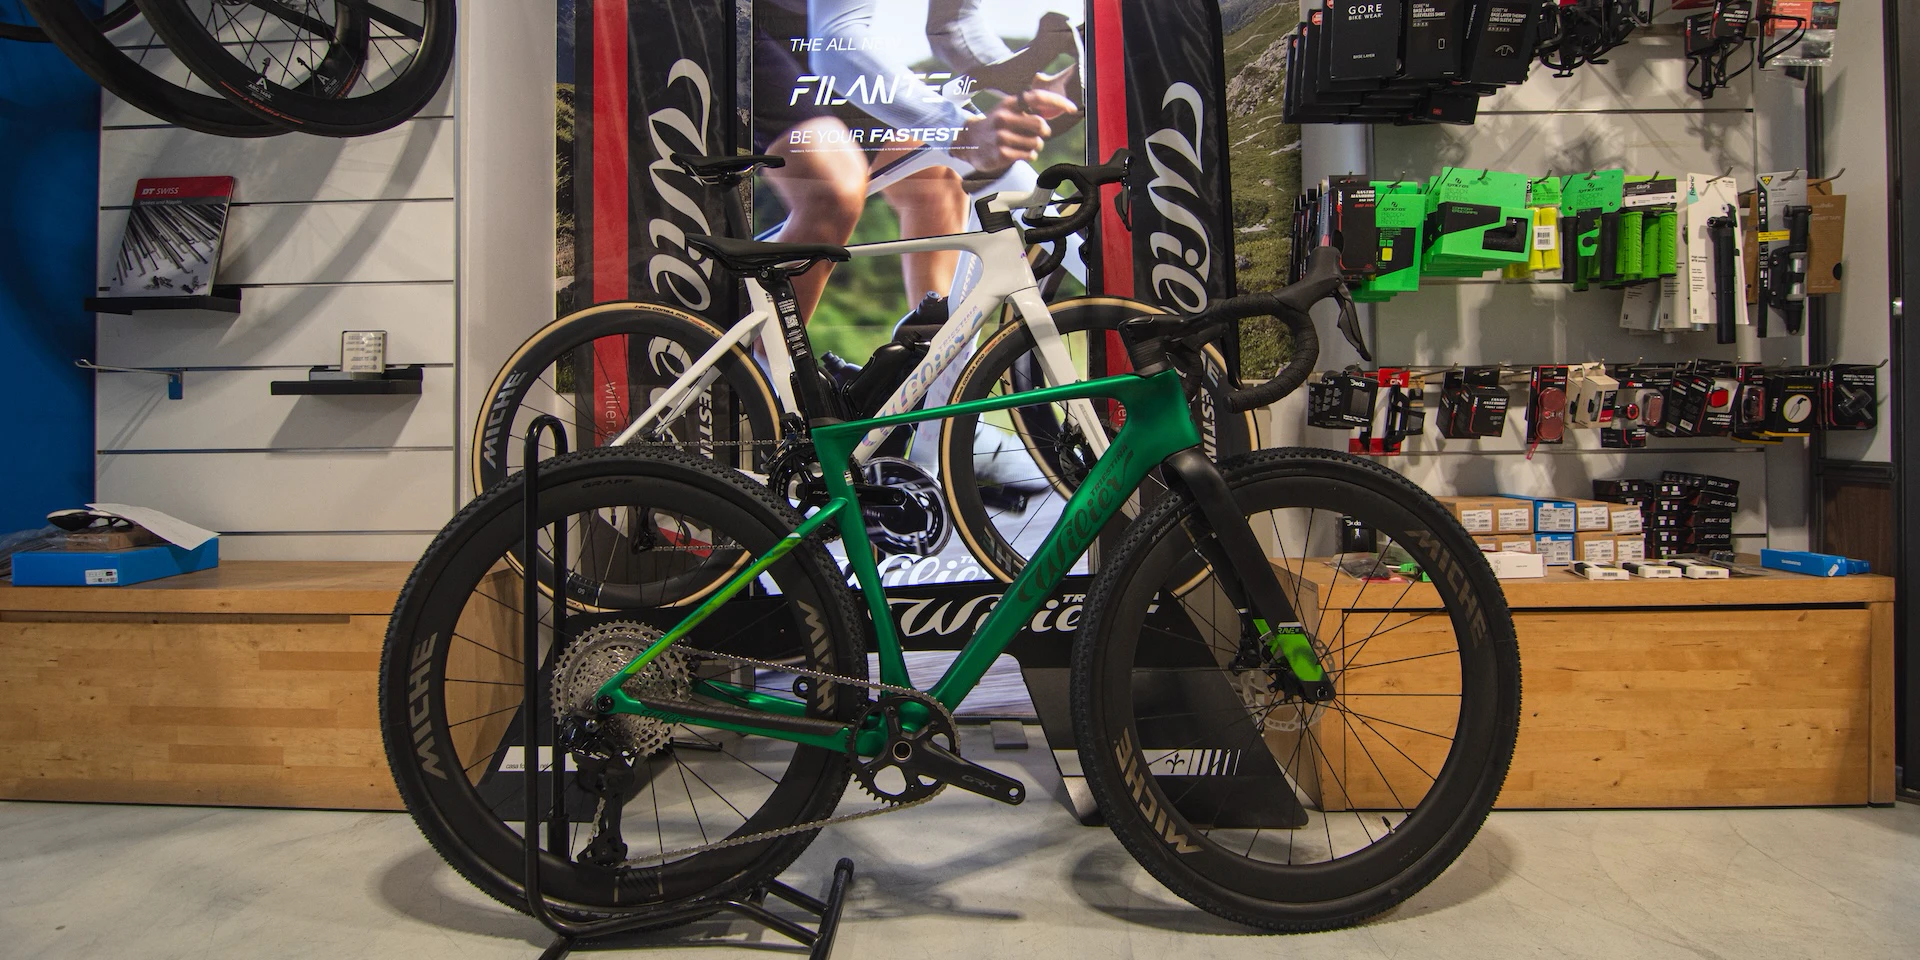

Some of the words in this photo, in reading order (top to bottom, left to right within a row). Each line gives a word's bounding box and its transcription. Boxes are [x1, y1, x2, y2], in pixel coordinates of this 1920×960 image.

[1348, 4, 1382, 15] GORE
[791, 38, 823, 52] THE
[826, 37, 857, 51] ALL
[256, 77, 268, 90] A
[317, 74, 330, 85] A
[789, 72, 952, 107] FILANTE
[790, 130, 813, 145] BE
[817, 130, 865, 144] YOUR
[156, 187, 180, 195] SWISS
[652, 307, 674, 315] CORSA
[675, 311, 689, 320] PRO
[962, 366, 976, 388] CORSA
[483, 371, 527, 469] MICHE
[1710, 499, 1736, 508] BUCLOS
[1017, 450, 1134, 603] Wilier
[1404, 530, 1487, 648] MICHE
[797, 600, 834, 716] MICH
[409, 632, 447, 780] MICHE
[961, 774, 997, 791] GRX
[1115, 727, 1204, 854] MICHE
